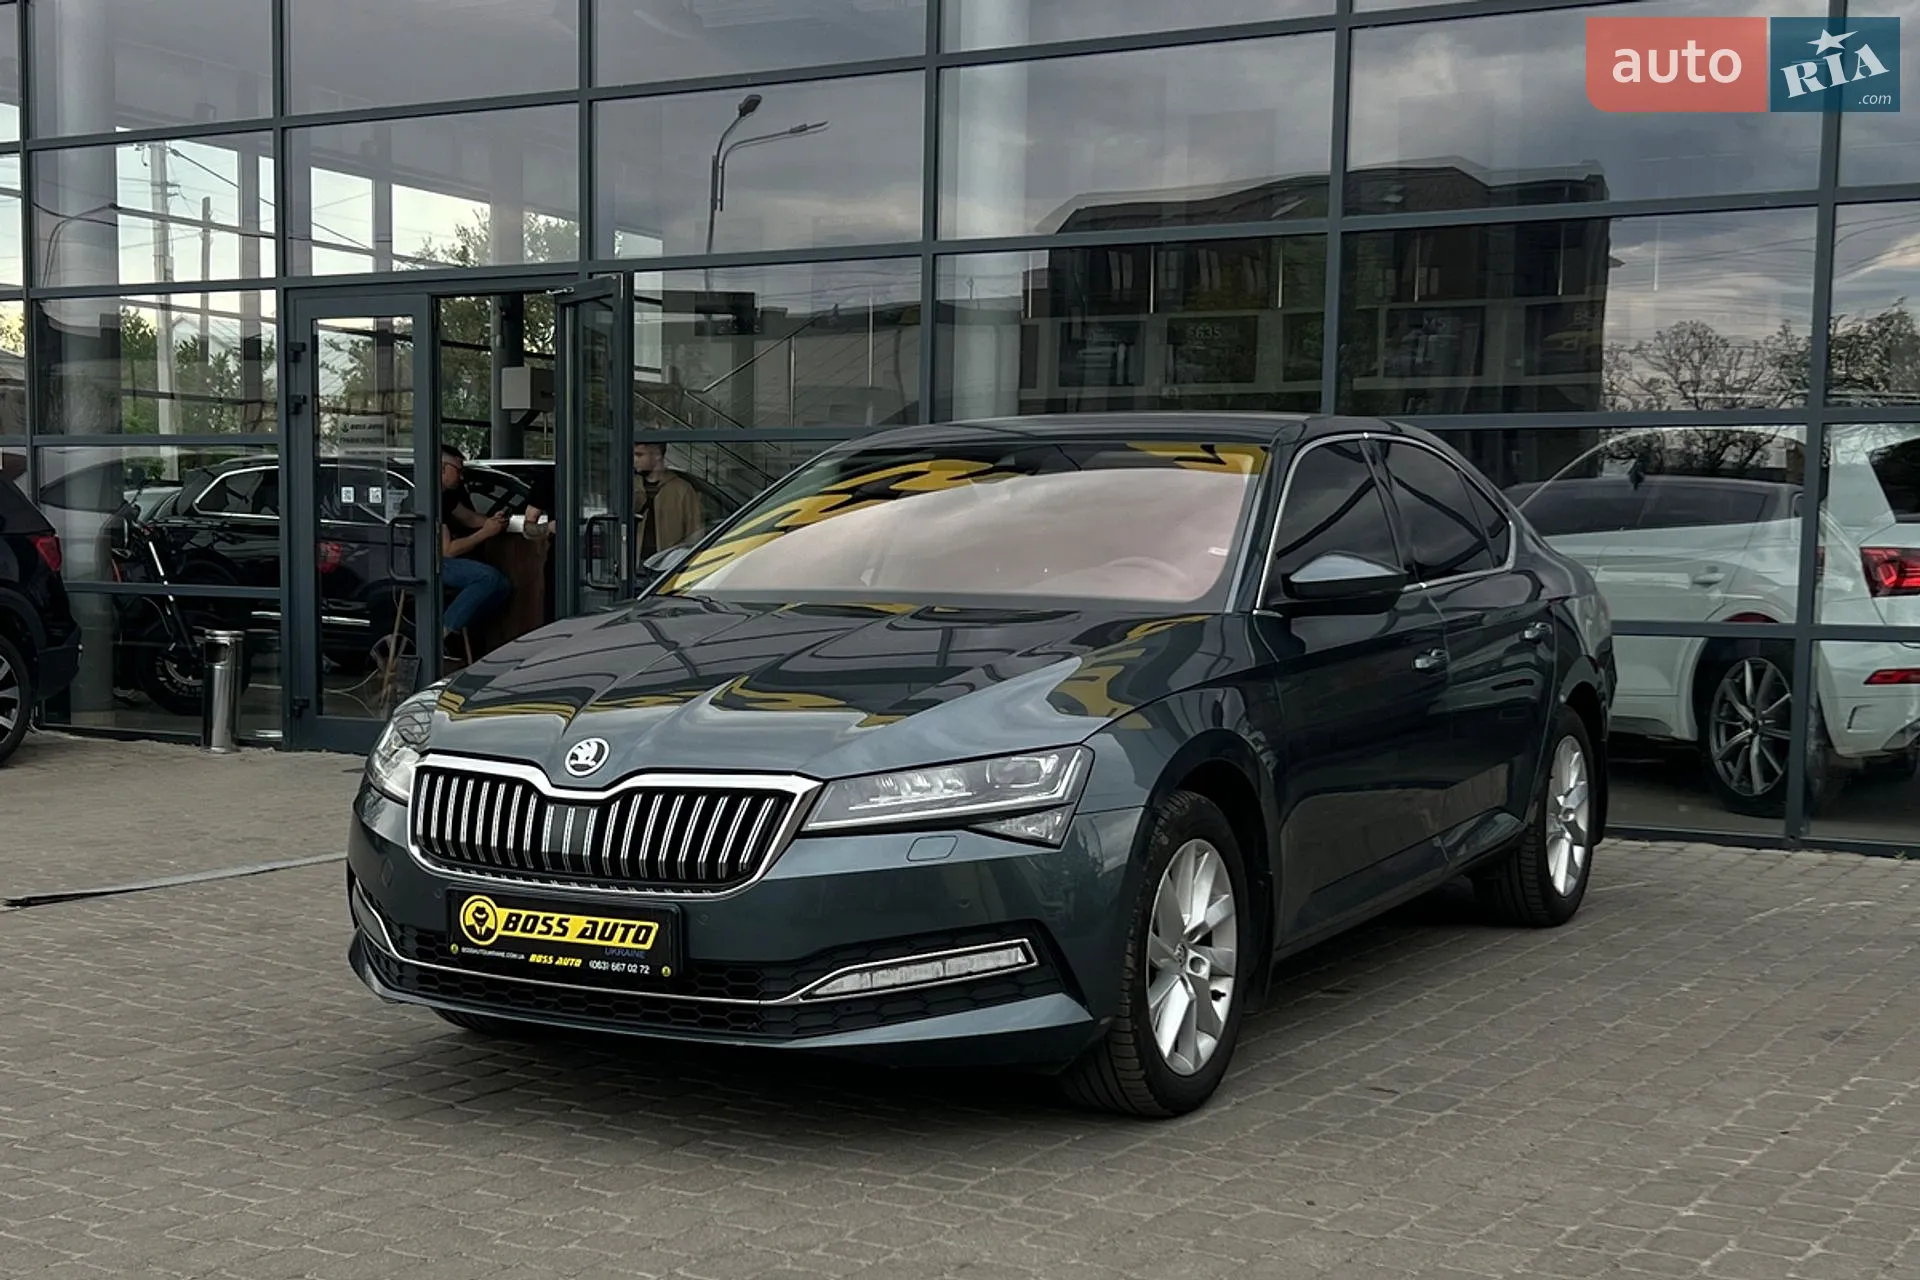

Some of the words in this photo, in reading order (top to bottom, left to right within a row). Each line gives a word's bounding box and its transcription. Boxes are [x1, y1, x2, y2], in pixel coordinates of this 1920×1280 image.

[502, 912, 571, 937] BOSS
[576, 919, 654, 945] AUTO
[604, 947, 646, 959] UKRAINE
[529, 954, 554, 965] BOSS
[555, 957, 582, 967] AUTO
[589, 960, 609, 971] (063)
[611, 962, 626, 973] 667
[627, 963, 638, 974] 02
[639, 964, 651, 976] 72
